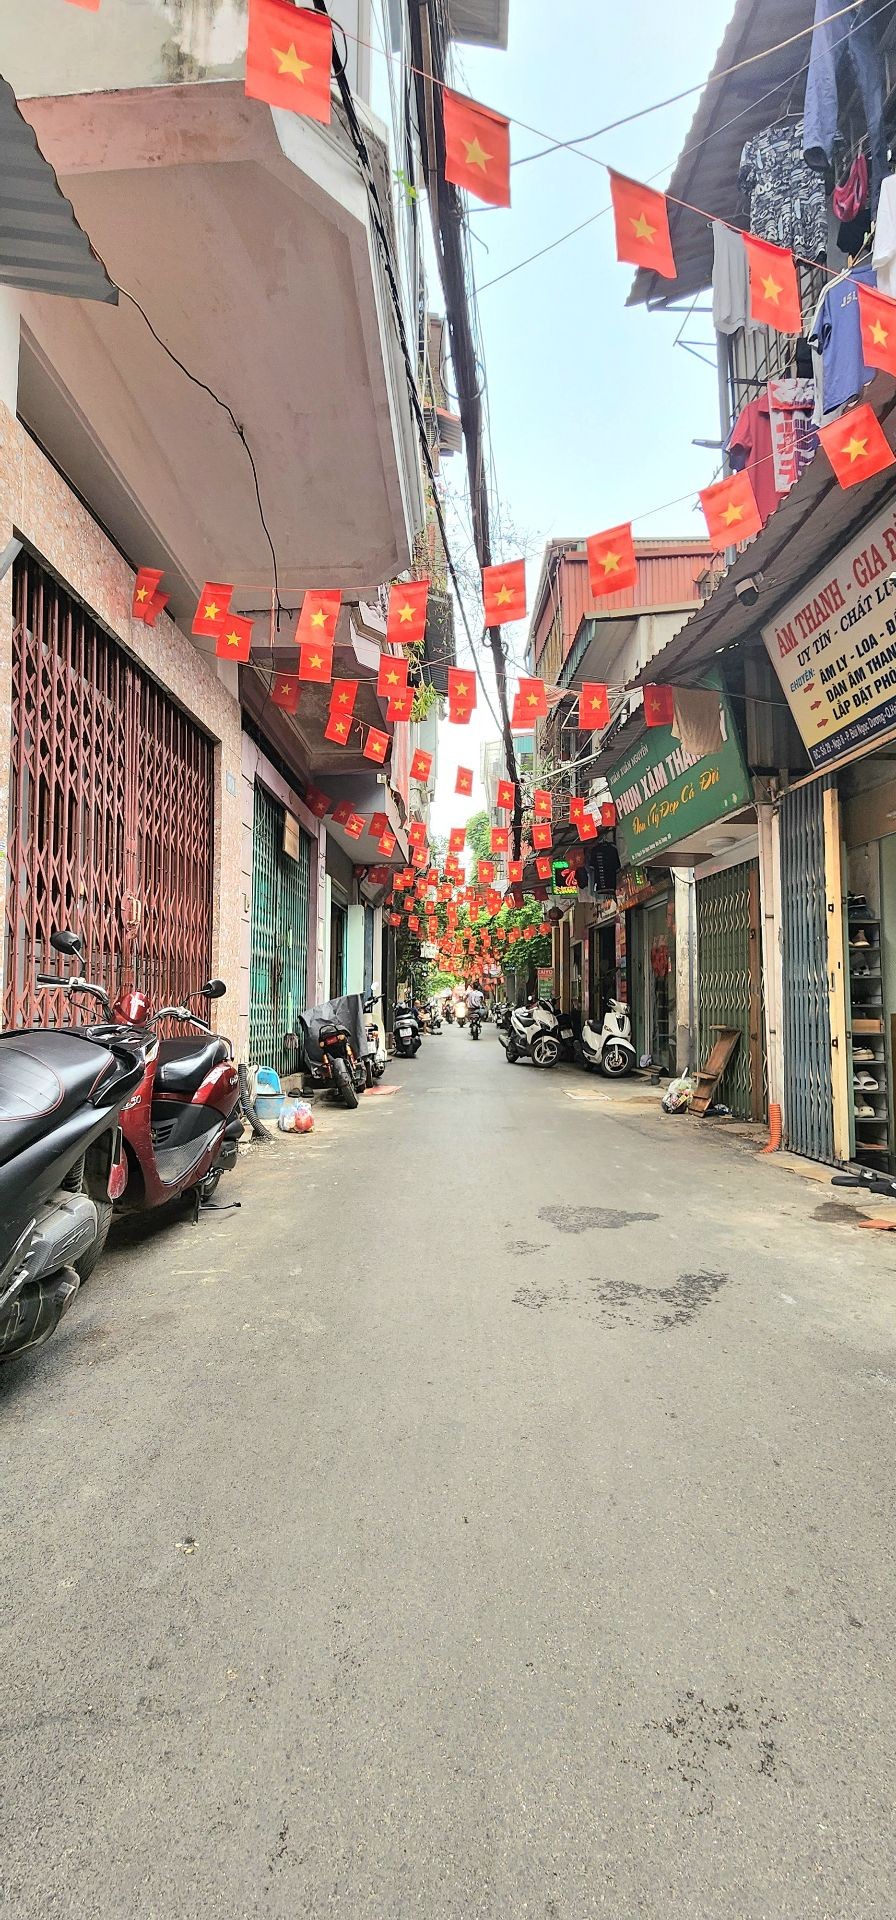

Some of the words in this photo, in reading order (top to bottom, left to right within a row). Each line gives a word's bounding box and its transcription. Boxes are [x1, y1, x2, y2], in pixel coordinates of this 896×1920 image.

[774, 627, 799, 658] ÂM
[794, 578, 847, 640] THANH
[852, 543, 888, 588] GIA
[797, 645, 811, 666] UY
[812, 628, 832, 655] TÍN
[840, 594, 874, 632] CHẤT
[819, 663, 837, 685] ÂM
[835, 654, 848, 673] LY
[855, 633, 879, 658] LOA
[825, 683, 848, 703] DÀN
[847, 666, 867, 688] ÂM
[852, 684, 873, 708] ĐẶT
[614, 782, 643, 820] PHUN
[639, 761, 669, 801] XĂM
